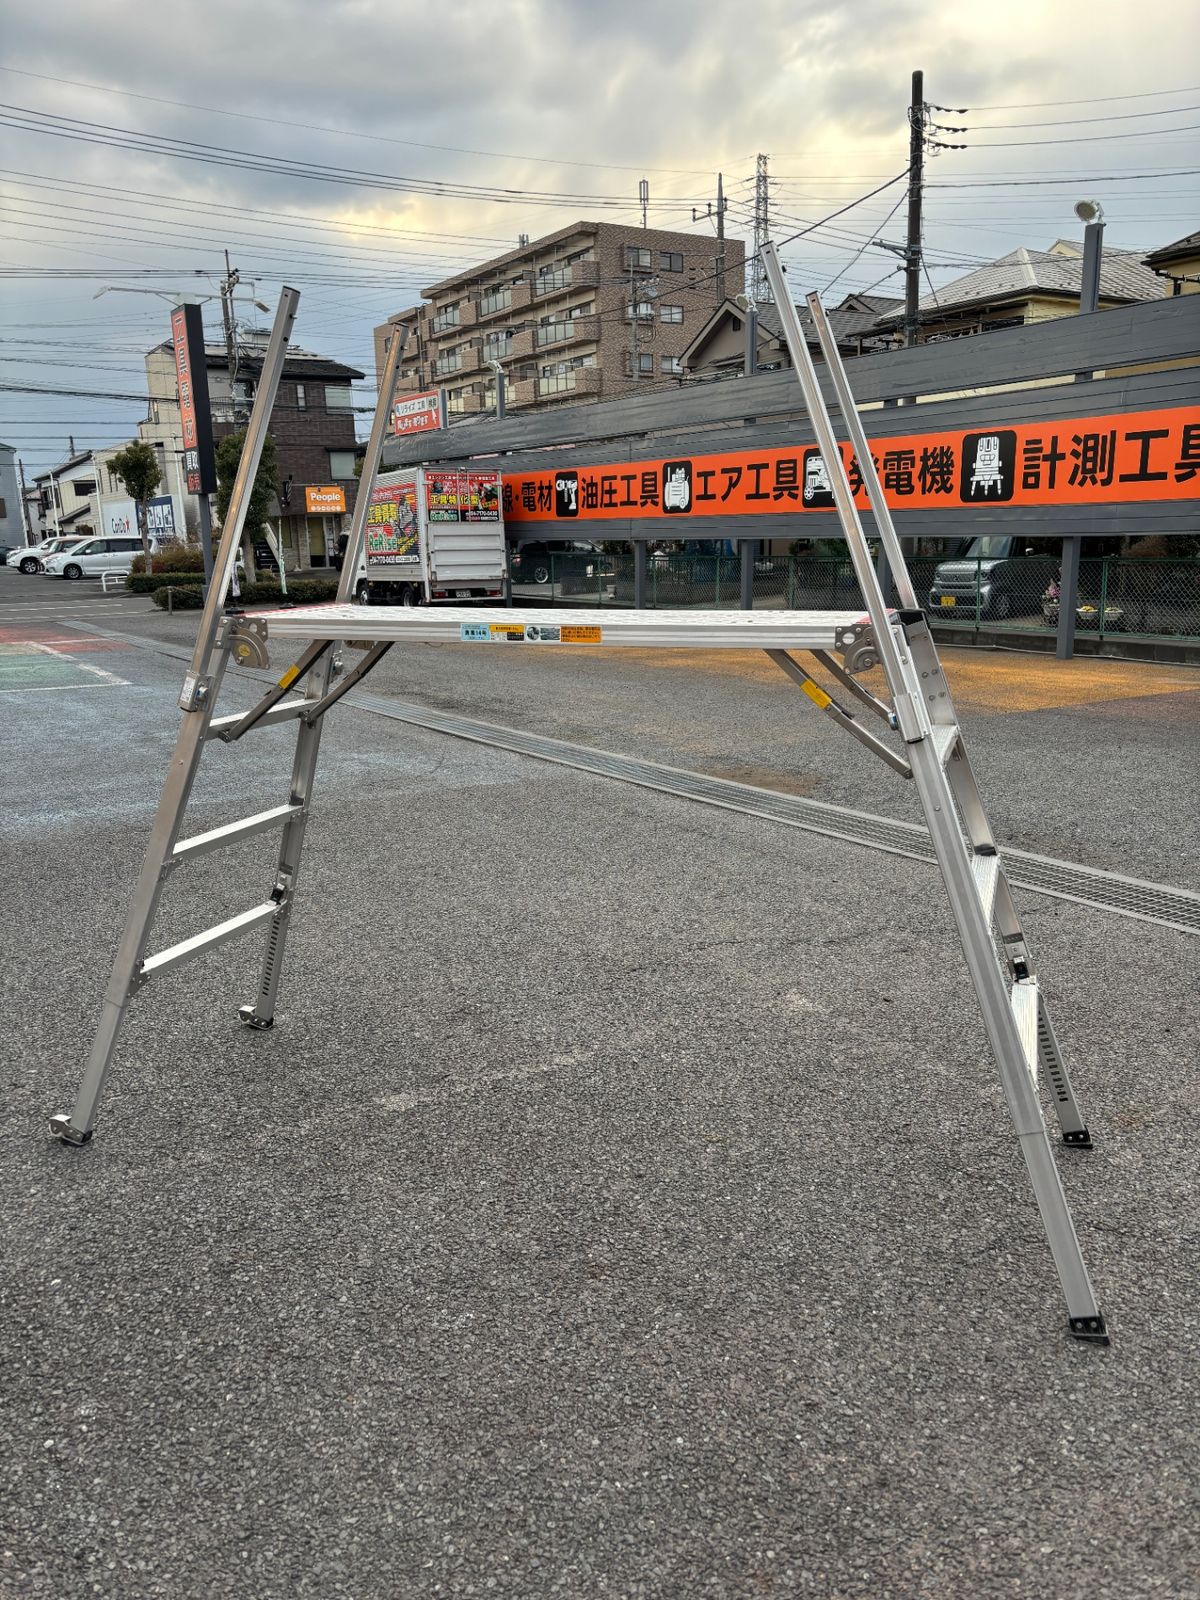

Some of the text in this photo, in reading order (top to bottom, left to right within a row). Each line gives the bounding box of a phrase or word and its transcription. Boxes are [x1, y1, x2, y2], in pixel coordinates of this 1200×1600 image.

[185, 451, 199, 470] 買取
[581, 471, 660, 510] 油圧工具
[696, 458, 800, 501] エア工具
[310, 492, 341, 503] People
